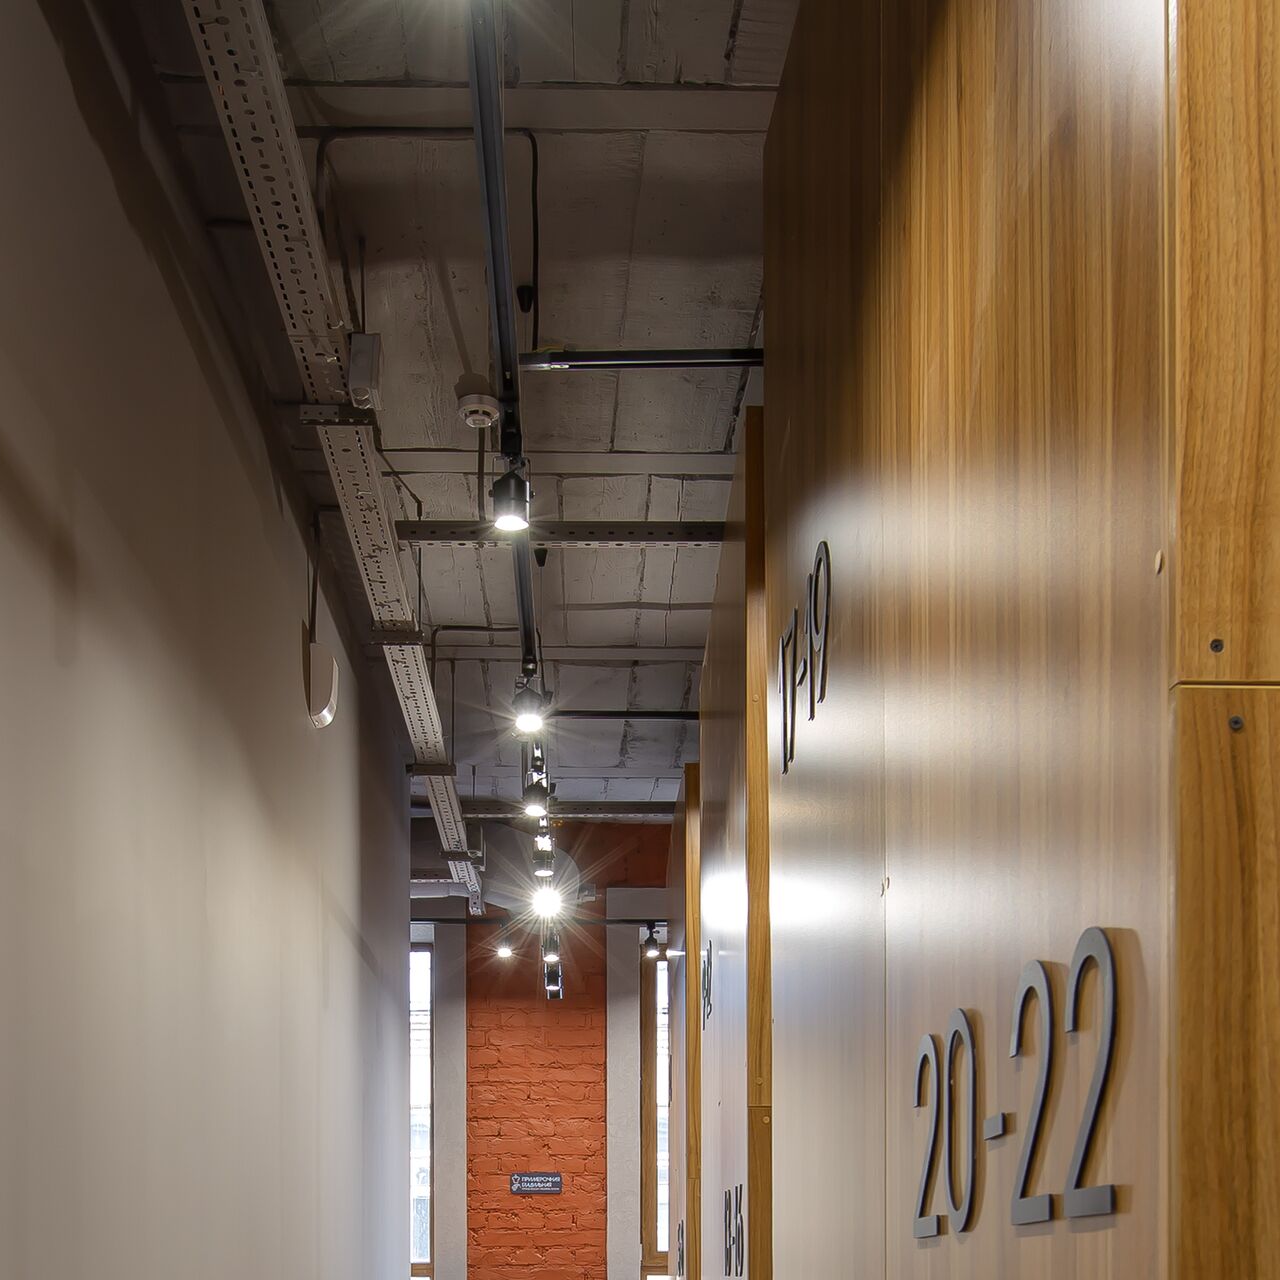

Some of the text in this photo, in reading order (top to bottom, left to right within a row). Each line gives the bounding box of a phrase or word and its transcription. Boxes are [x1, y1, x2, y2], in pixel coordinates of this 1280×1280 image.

[777, 540, 832, 775] 17-19
[912, 926, 1117, 1239] 20-22
[724, 1183, 745, 1277] 13-16
